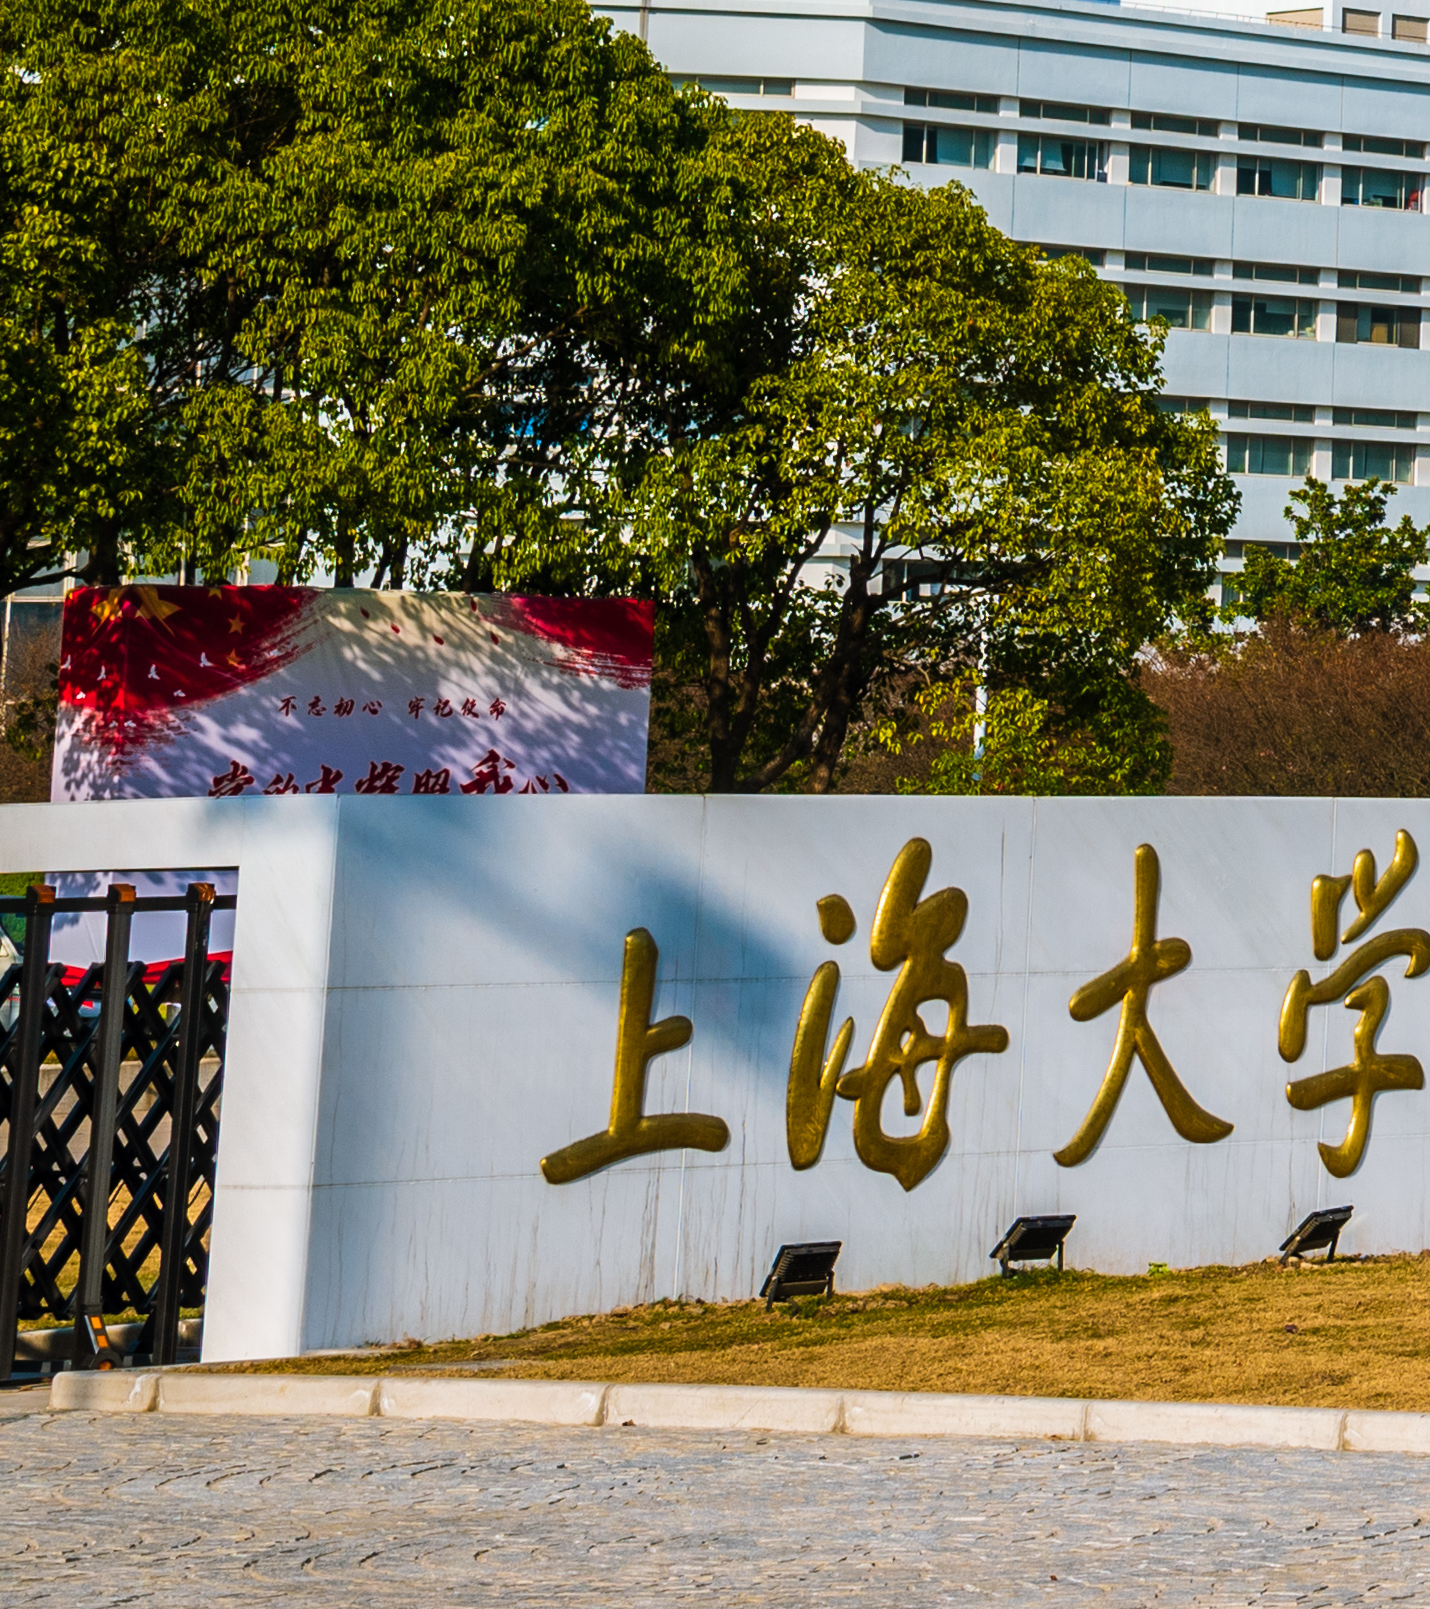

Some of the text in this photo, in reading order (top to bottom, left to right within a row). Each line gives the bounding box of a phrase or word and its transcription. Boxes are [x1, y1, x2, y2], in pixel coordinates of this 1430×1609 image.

[277, 695, 507, 721] 不忘初心 牢记使命
